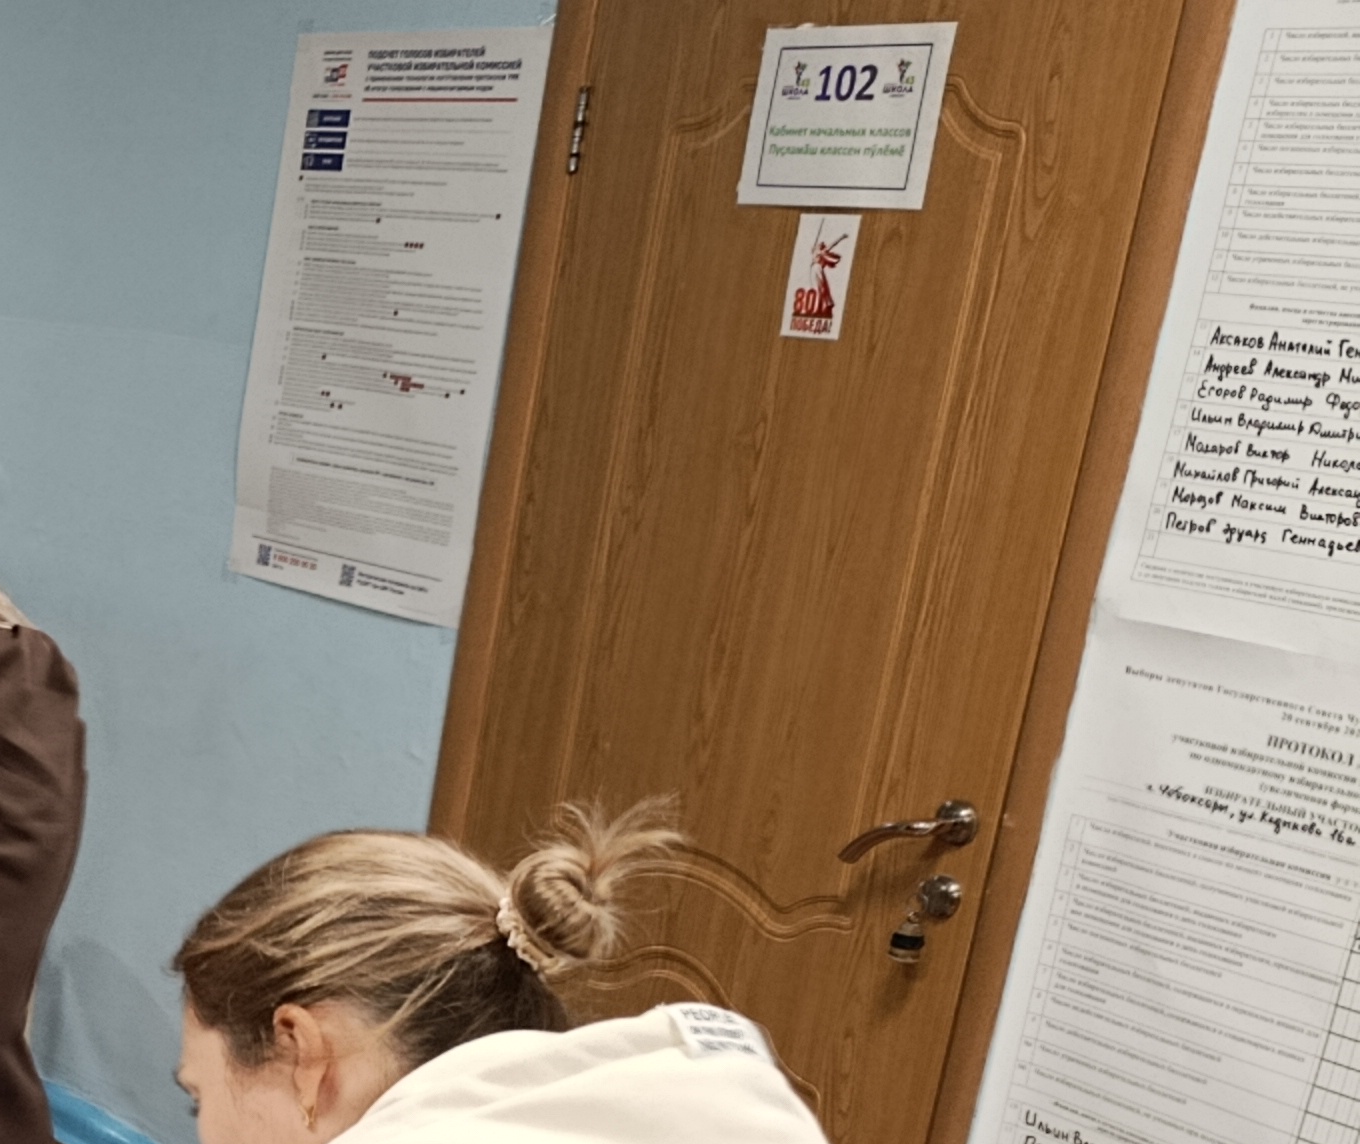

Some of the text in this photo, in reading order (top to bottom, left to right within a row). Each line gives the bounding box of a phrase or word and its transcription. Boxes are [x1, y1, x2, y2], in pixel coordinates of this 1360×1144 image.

[814, 64, 879, 102] 102
[882, 84, 914, 95] ШКОЛА
[769, 124, 808, 137] Кабинет
[869, 127, 912, 137] классов
[1204, 353, 1258, 382] Андреев
[1197, 379, 1247, 400] Егоров
[1191, 407, 1233, 426] Ильин
[1237, 412, 1305, 437] Владимир
[1173, 459, 1241, 483] Михайлов
[1231, 493, 1287, 515] Максим
[1165, 511, 1217, 534] Петров
[1125, 665, 1163, 682] Выборы
[1266, 733, 1356, 768] ПРОТОКОЛ
[1025, 1109, 1069, 1141] Ильин
